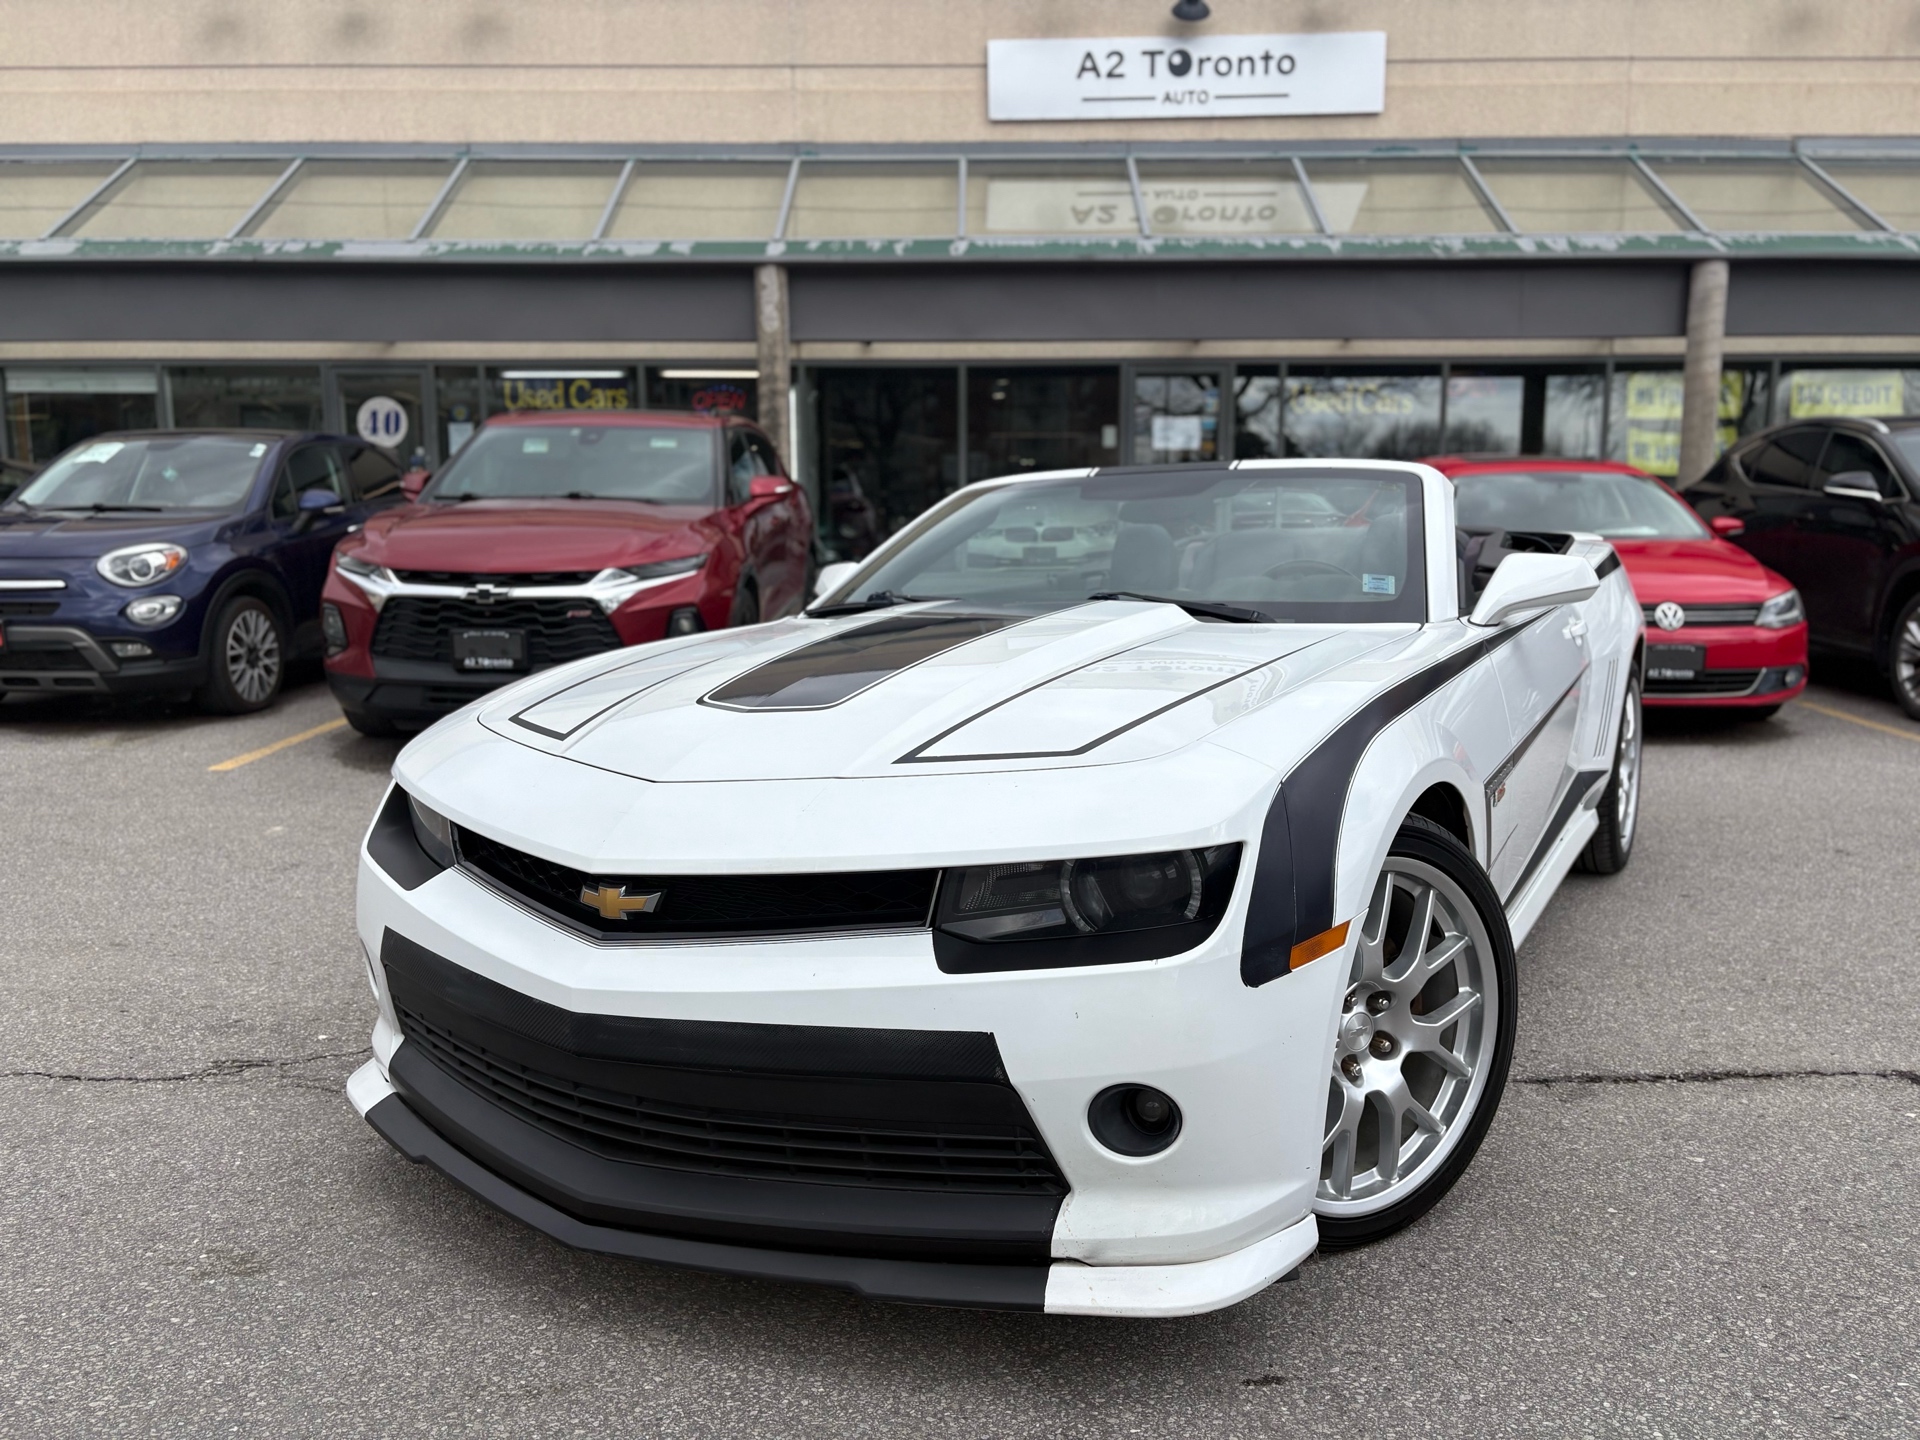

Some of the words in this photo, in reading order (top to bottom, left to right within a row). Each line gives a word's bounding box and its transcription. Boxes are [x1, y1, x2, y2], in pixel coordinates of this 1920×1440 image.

[1076, 51, 1126, 79] A2
[1161, 90, 1210, 105] AUTO
[503, 379, 565, 410] Used
[568, 378, 629, 410] Cars
[1355, 384, 1414, 415] Cars
[1827, 383, 1893, 405] CREDIT
